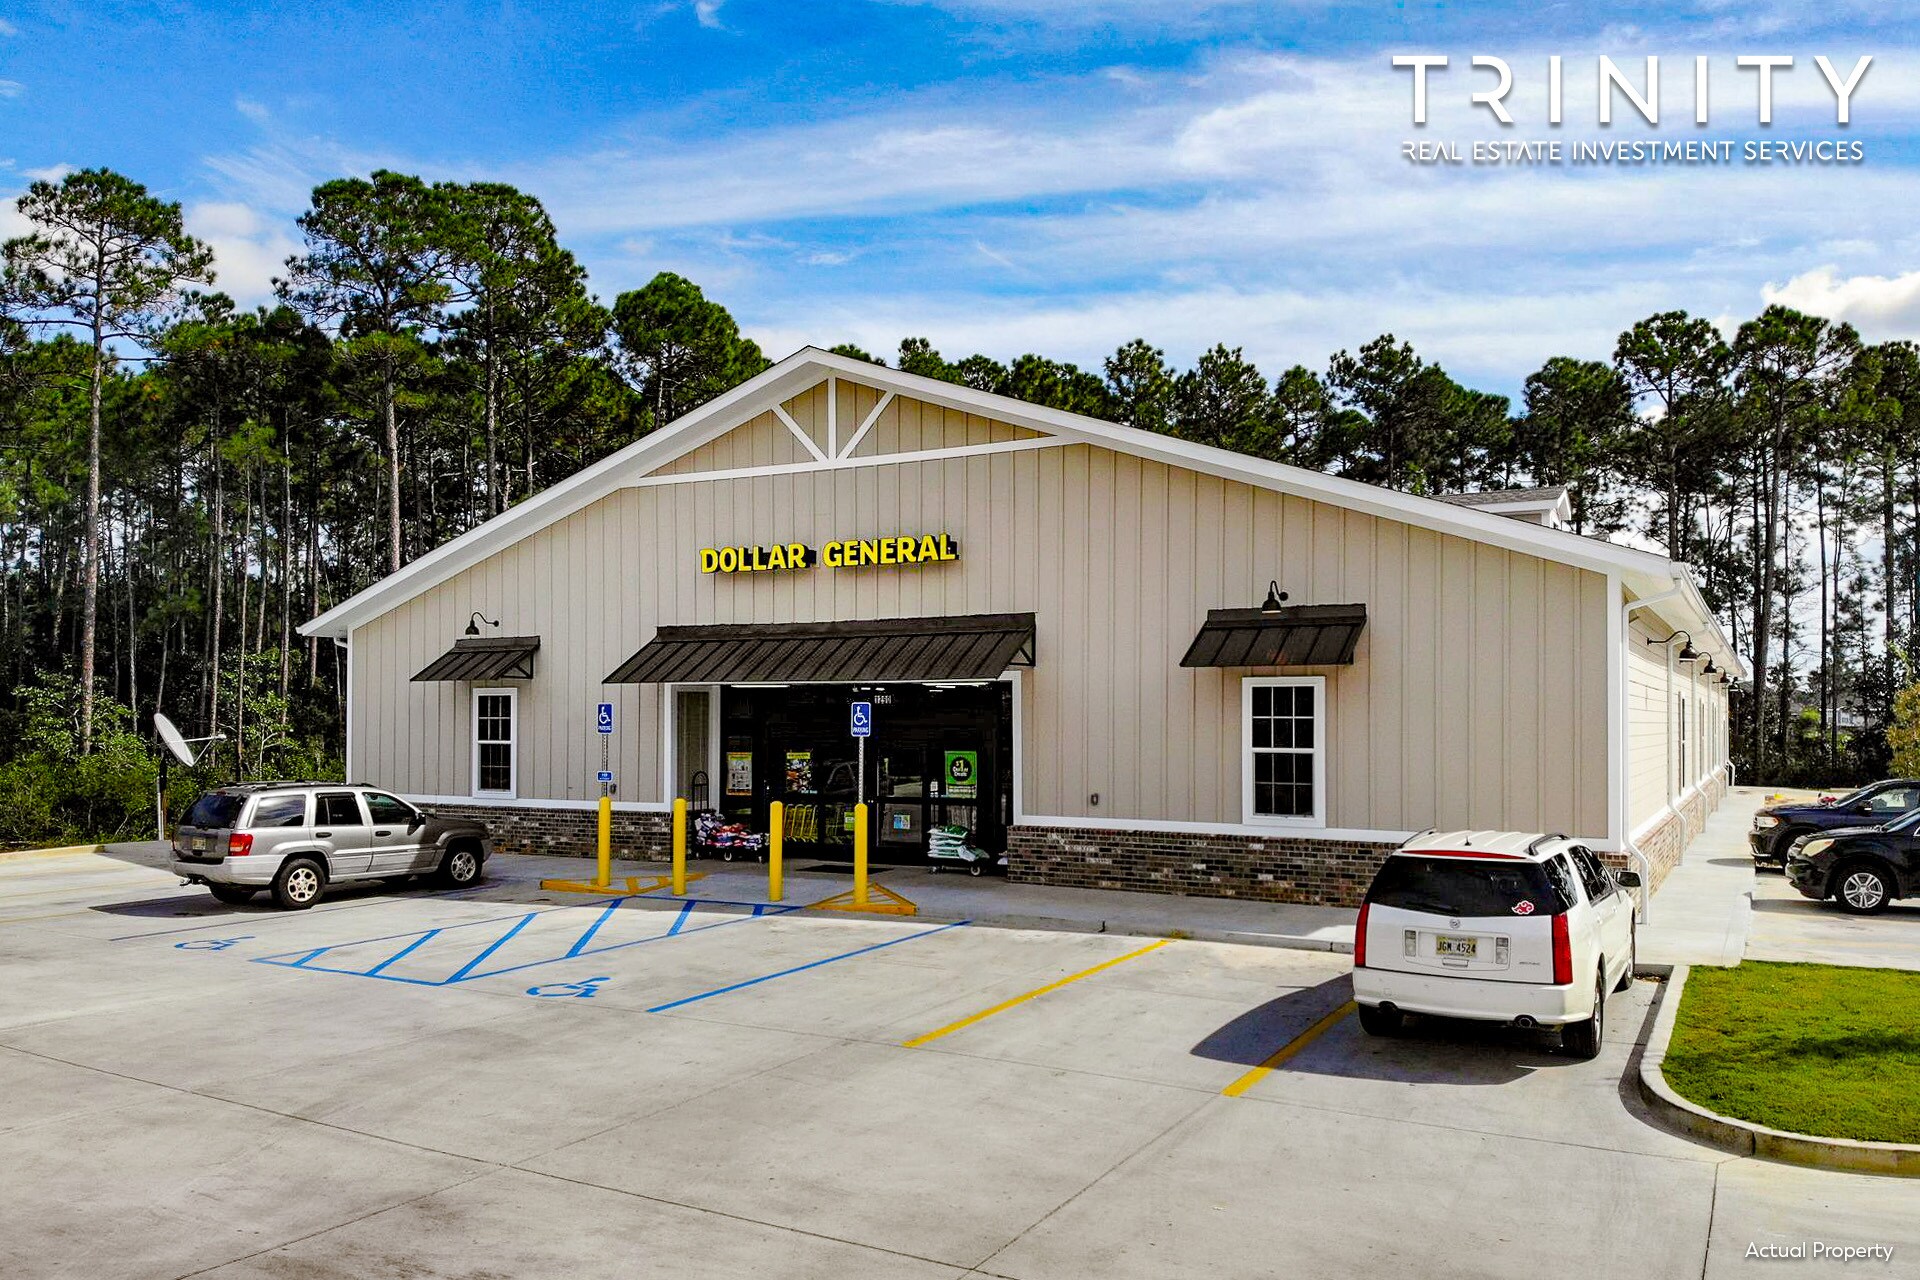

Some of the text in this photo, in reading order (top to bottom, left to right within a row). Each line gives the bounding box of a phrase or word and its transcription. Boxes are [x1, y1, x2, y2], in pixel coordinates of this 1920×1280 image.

[700, 533, 957, 574] DOLLAR GENERAL
[1457, 944, 1476, 953] 4524
